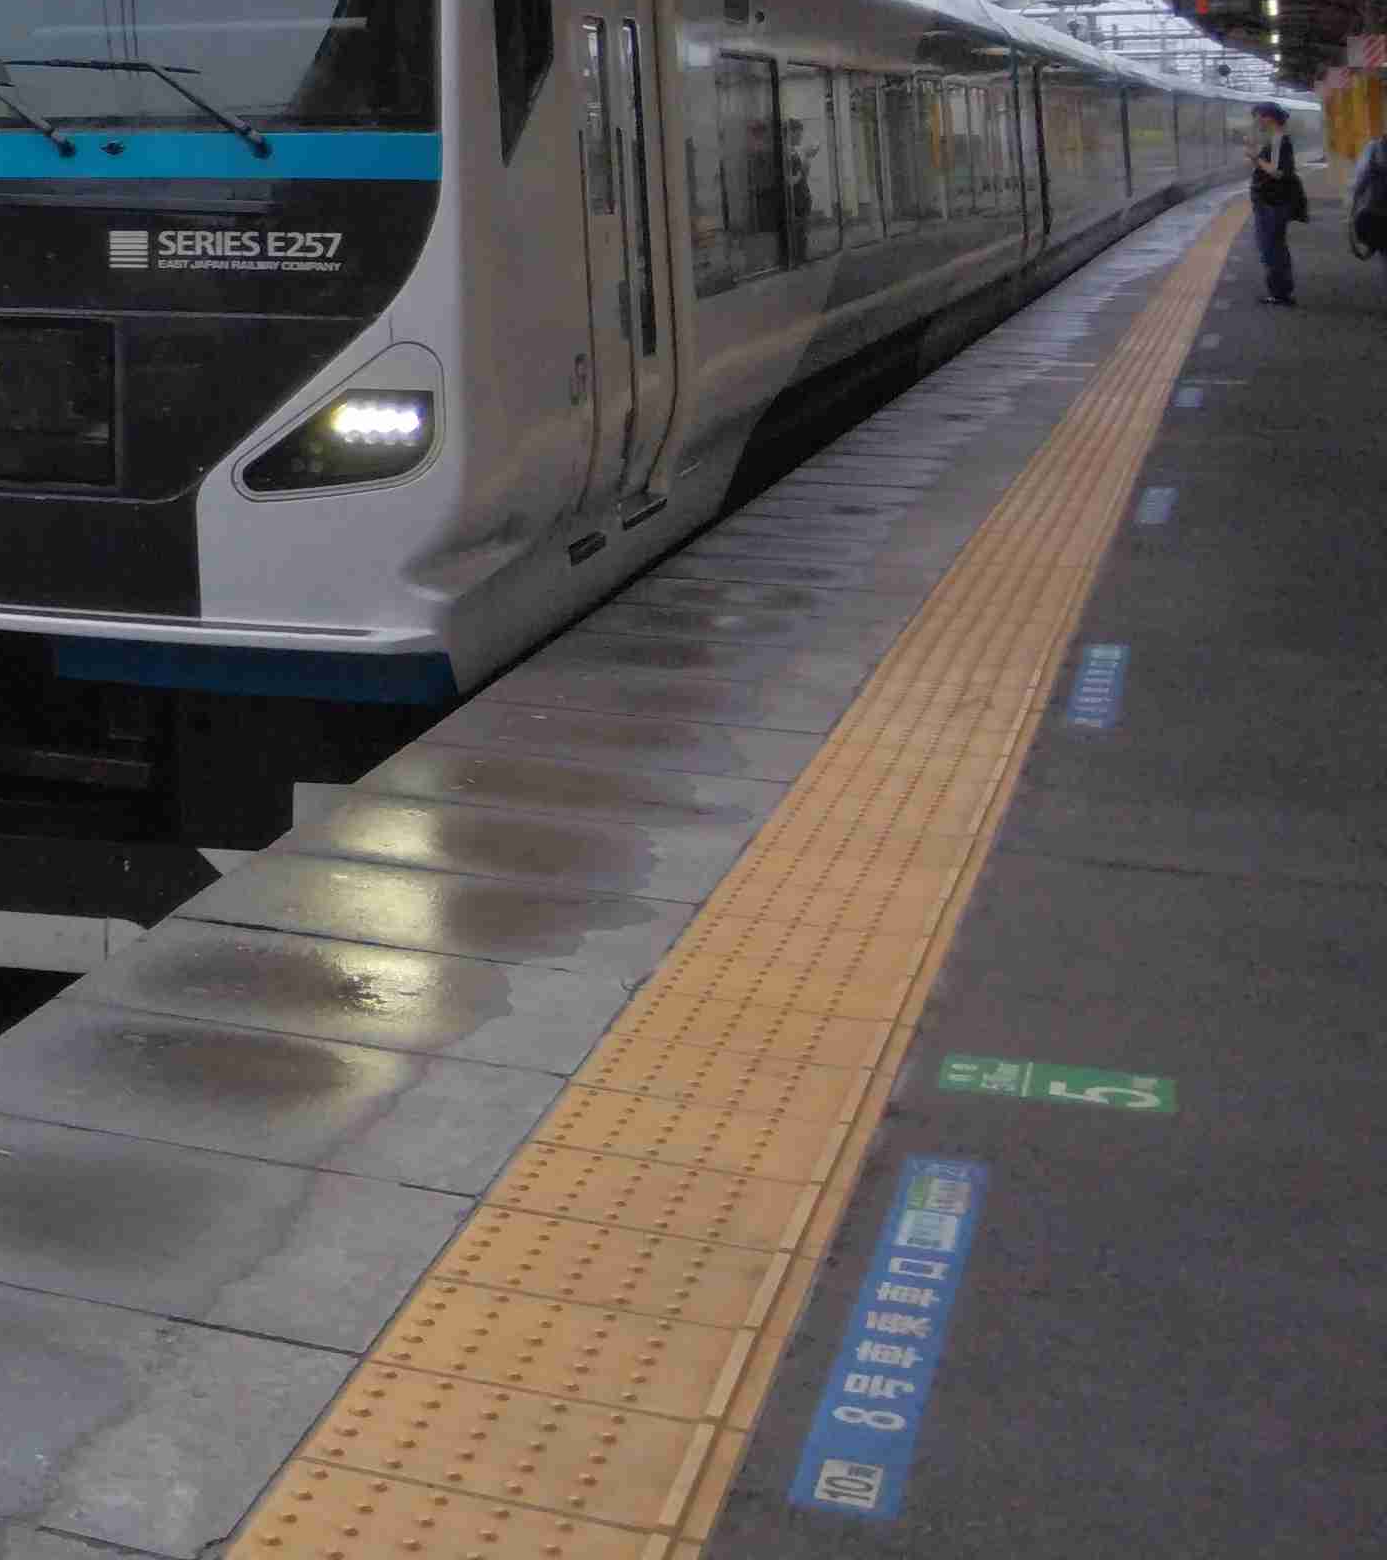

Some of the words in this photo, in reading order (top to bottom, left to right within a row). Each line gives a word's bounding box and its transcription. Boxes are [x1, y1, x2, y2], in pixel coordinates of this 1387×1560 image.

[158, 230, 260, 257] SERIES
[267, 231, 342, 258] E257
[158, 259, 187, 270] EAST
[190, 260, 228, 271] JAPAN
[231, 260, 279, 271] RAILWAY
[281, 261, 342, 272] COMPANY
